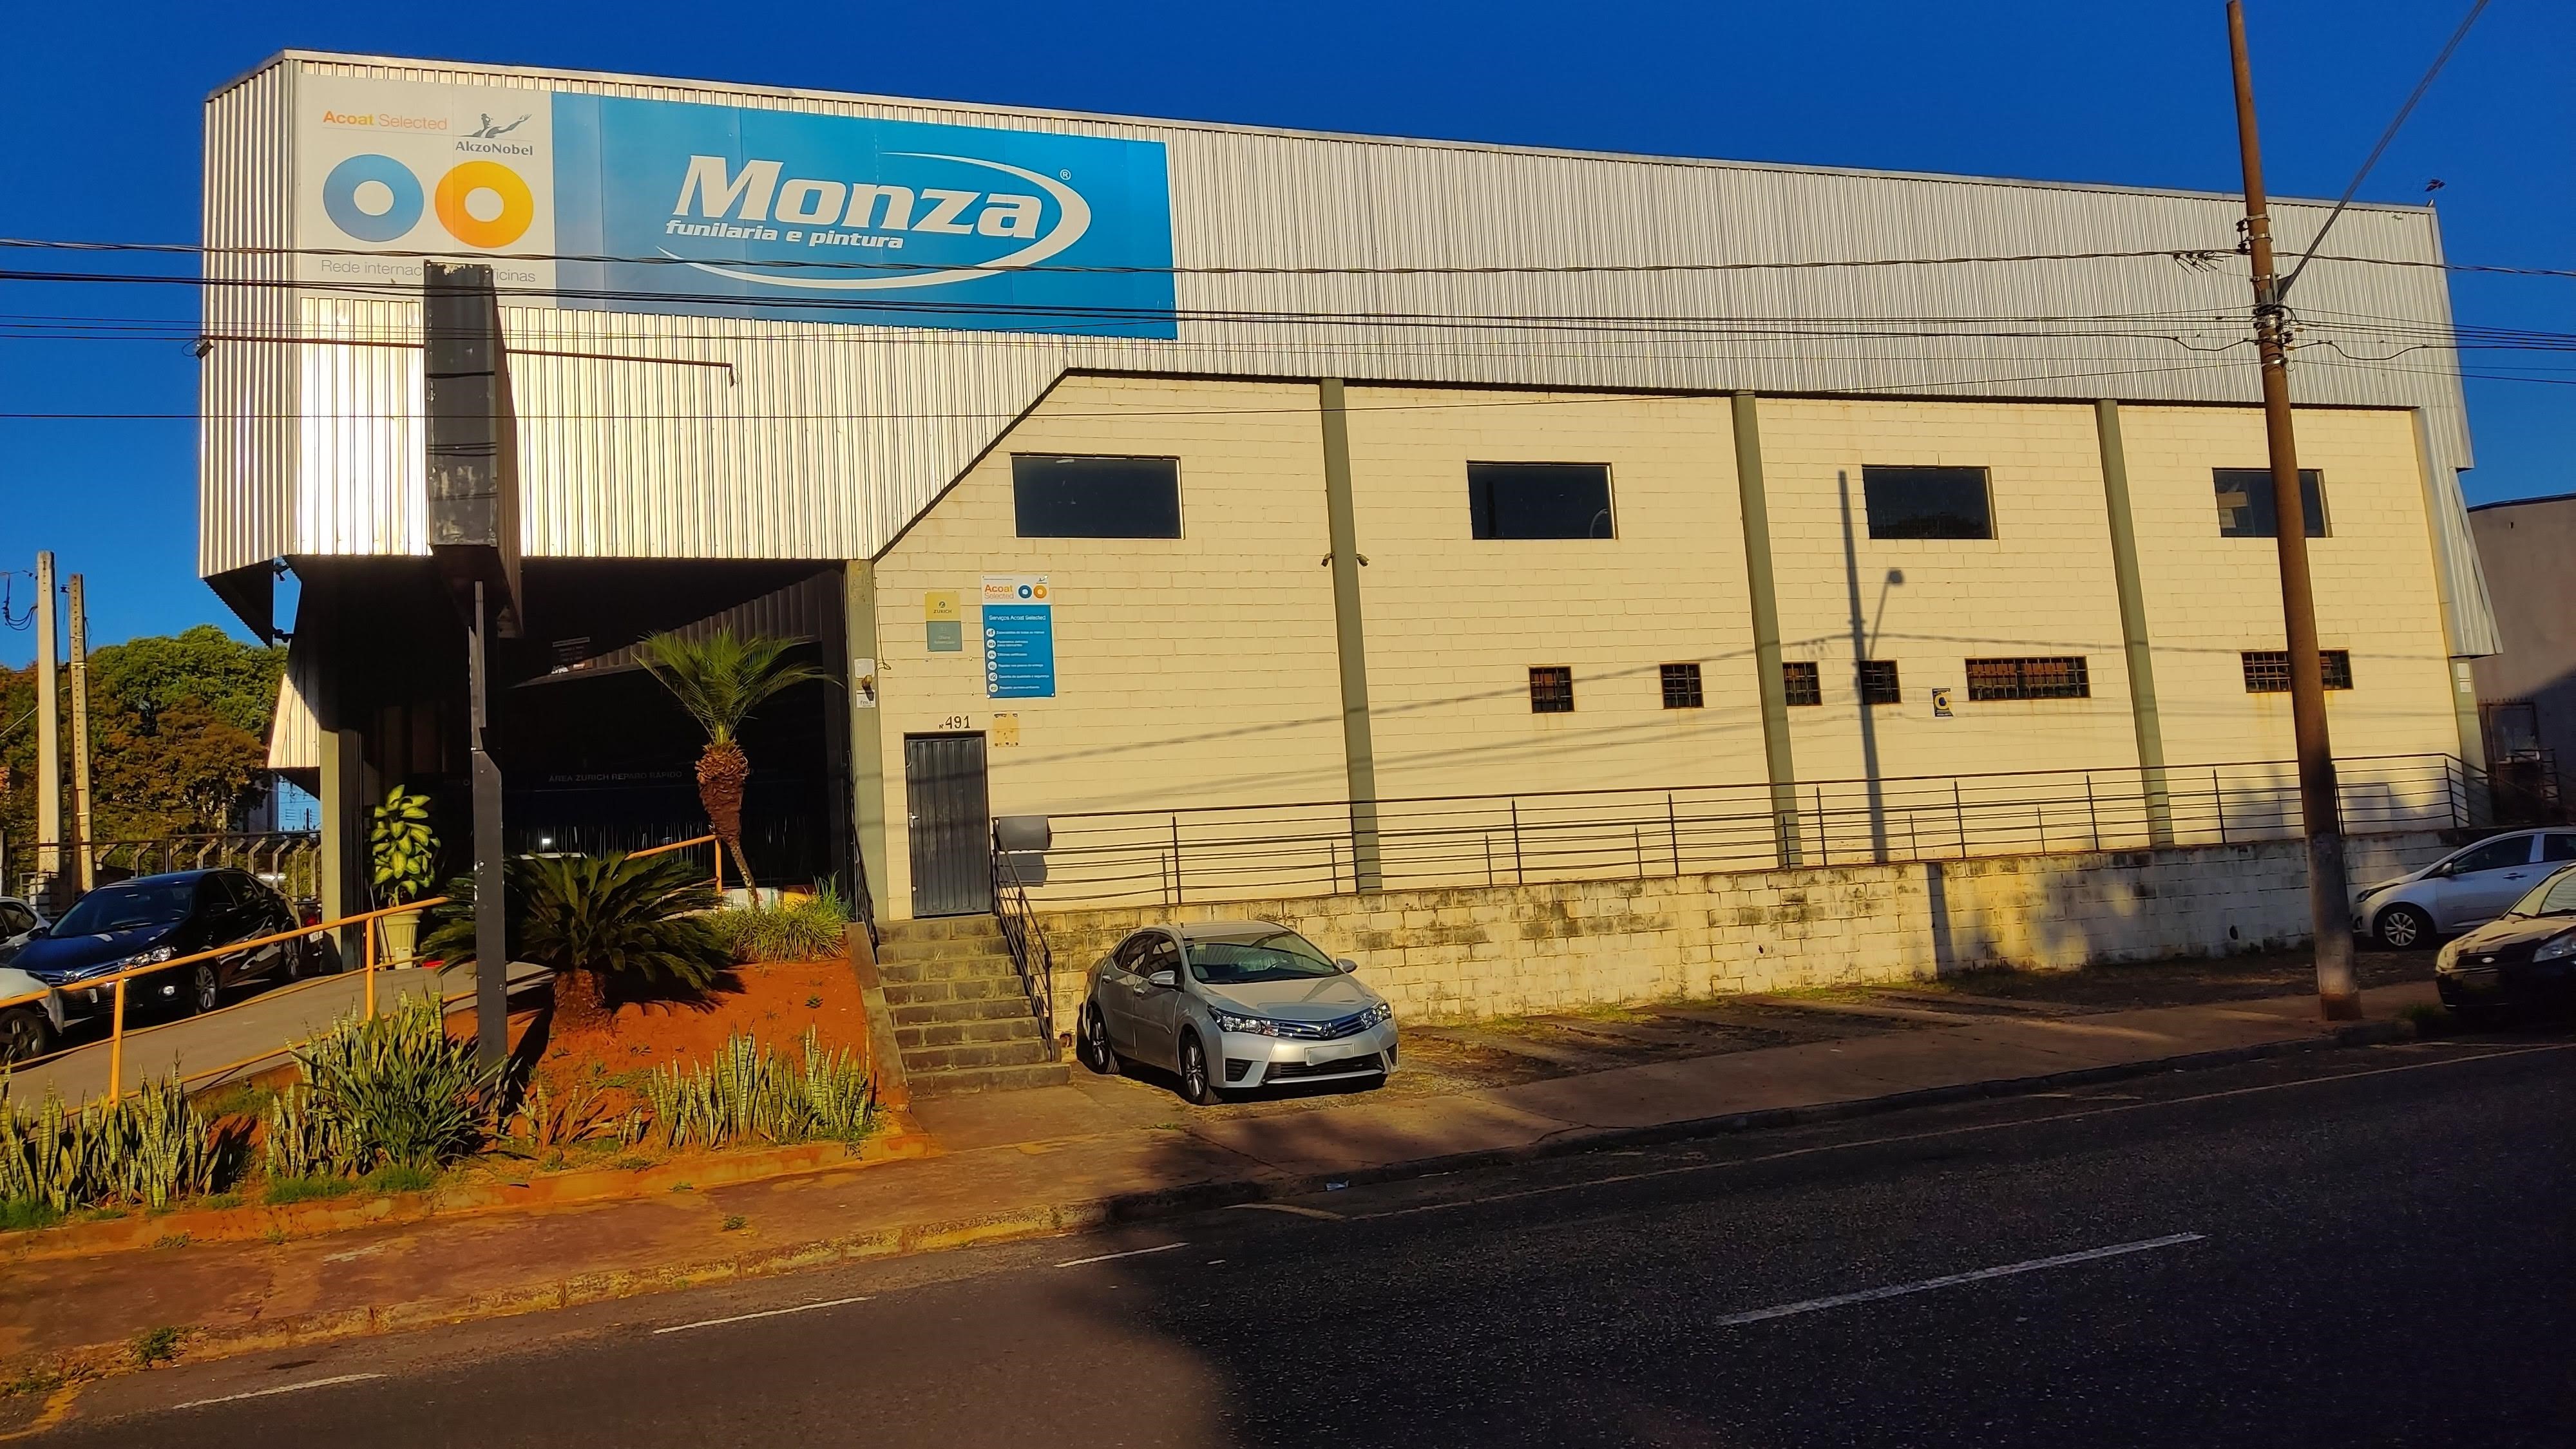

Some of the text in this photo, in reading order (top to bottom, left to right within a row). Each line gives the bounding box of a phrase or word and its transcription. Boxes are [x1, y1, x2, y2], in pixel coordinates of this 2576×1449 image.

[323, 110, 447, 130] Acoat Selected
[455, 141, 533, 156] AkzoNobel
[672, 155, 1042, 240] Monza
[665, 220, 904, 249] funilaria e pintura
[321, 260, 536, 283] Rede internac ficinas
[984, 584, 1013, 592] Acoat
[945, 715, 971, 729] 491
